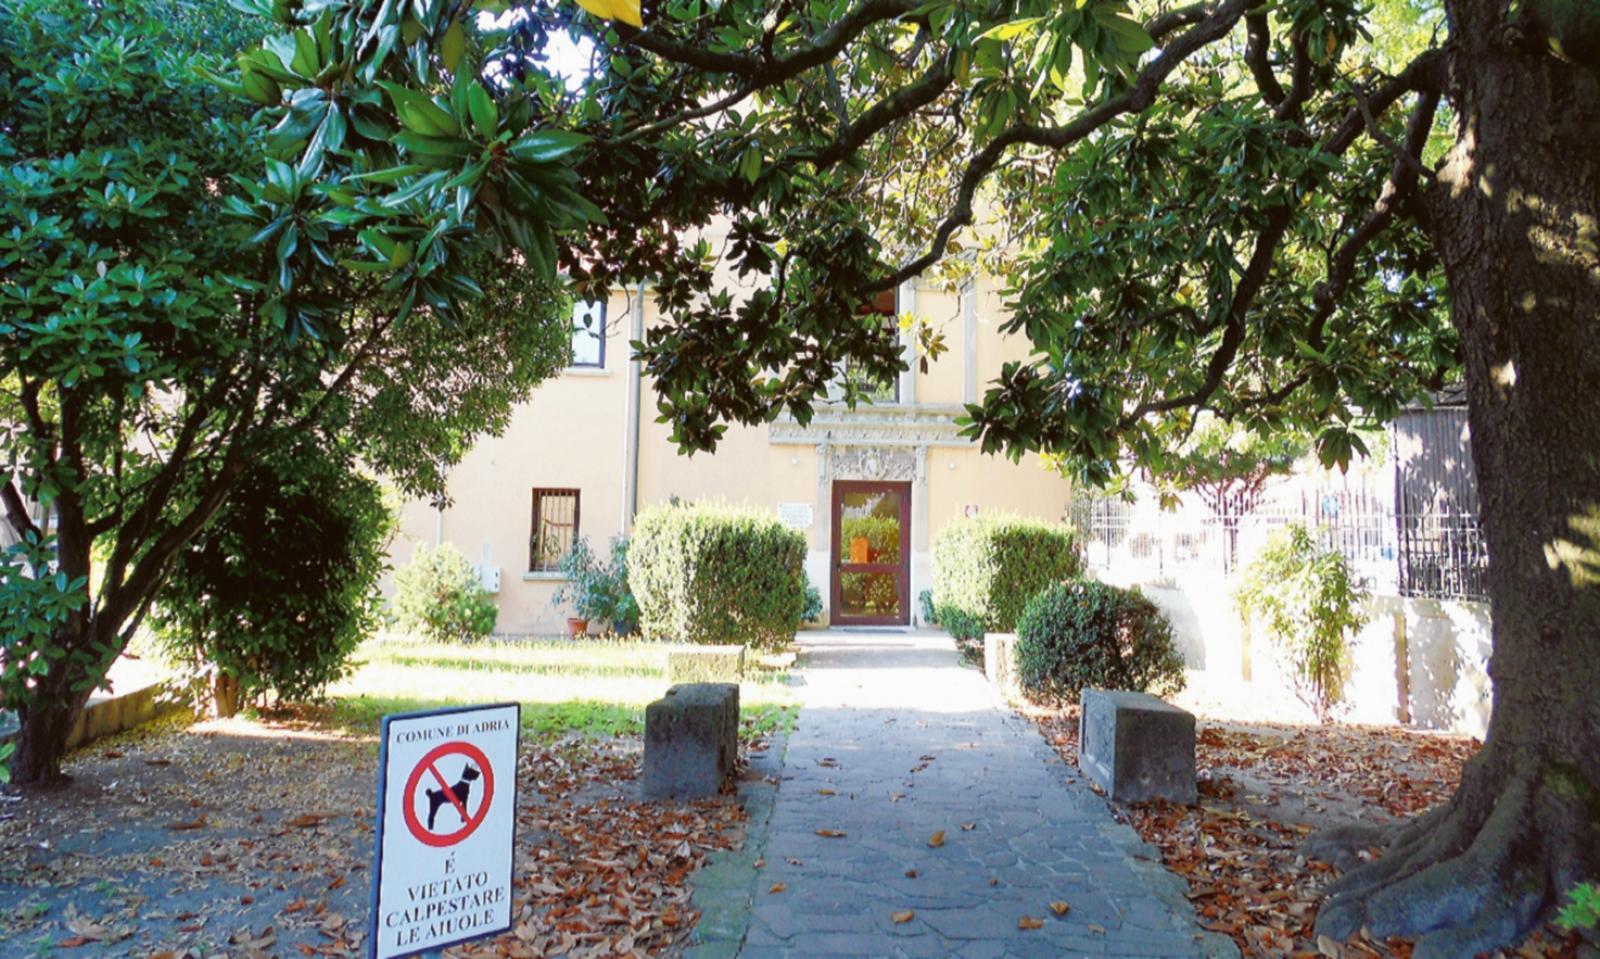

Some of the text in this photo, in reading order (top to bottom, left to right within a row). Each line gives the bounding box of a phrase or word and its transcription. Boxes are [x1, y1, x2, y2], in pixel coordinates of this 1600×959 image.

[397, 720, 510, 743] COMUNE DI ADRIA
[408, 872, 488, 901] VIETATO
[386, 887, 505, 928] CALPESTARE
[397, 910, 494, 947] LE AIUOLE
